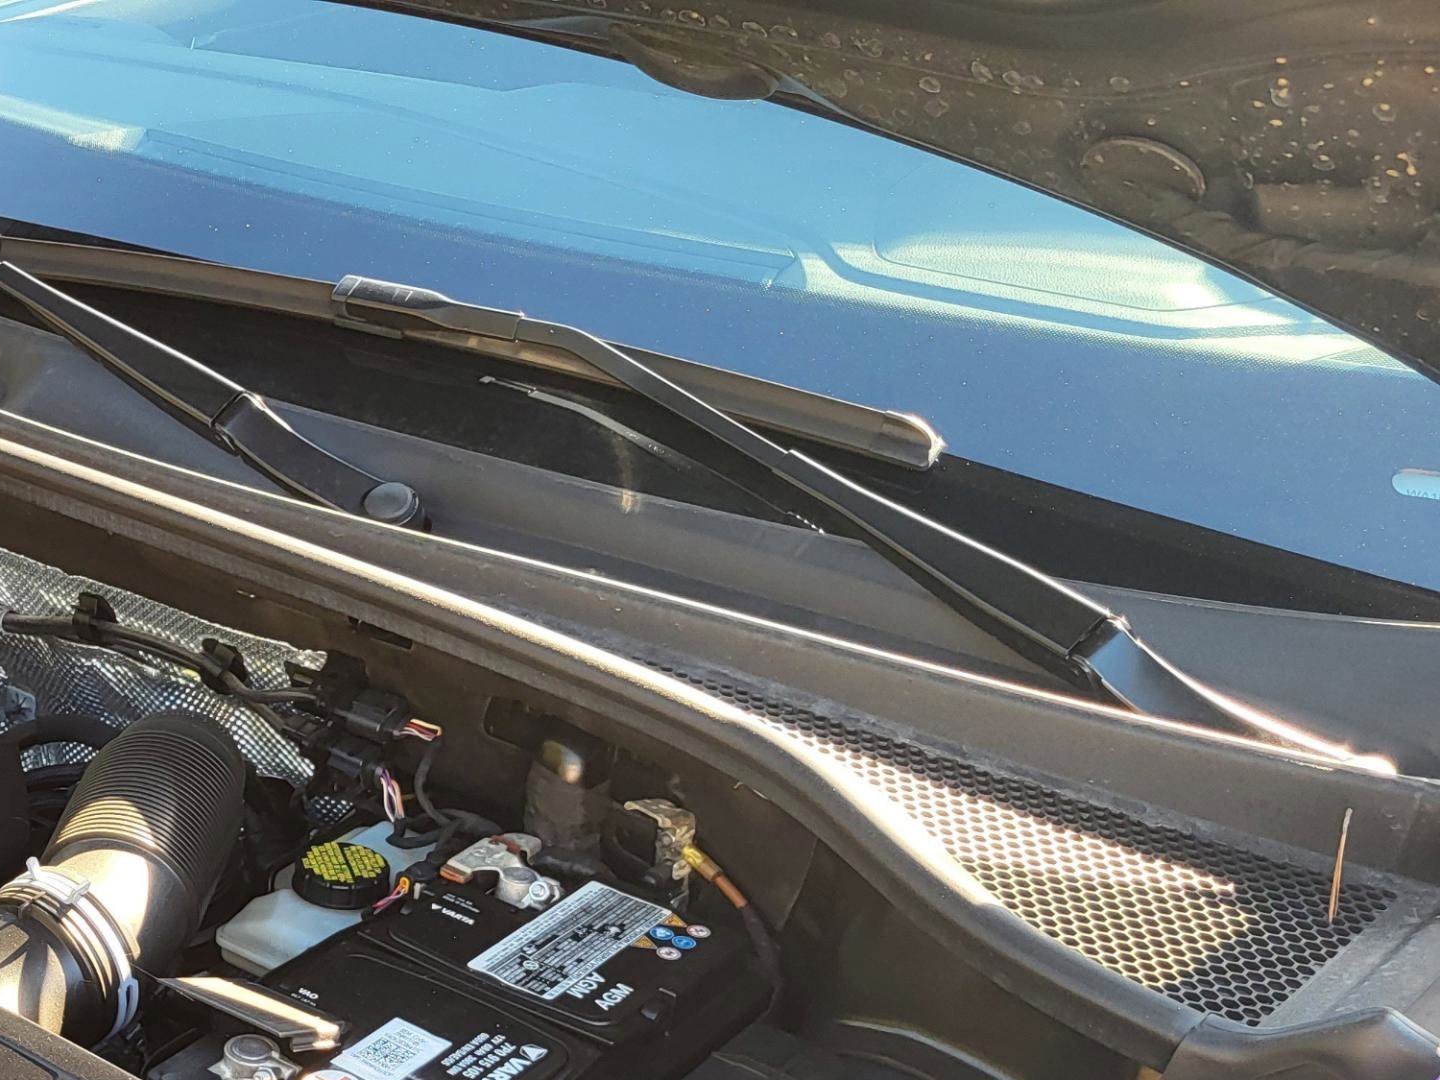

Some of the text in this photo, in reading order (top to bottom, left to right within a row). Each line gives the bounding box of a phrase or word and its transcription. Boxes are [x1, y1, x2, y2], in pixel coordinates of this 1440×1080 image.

[441, 908, 475, 925] VARTA
[566, 972, 606, 999] AGM
[594, 982, 634, 1011] AGM
[463, 1042, 516, 1079] 7P0 915 105
